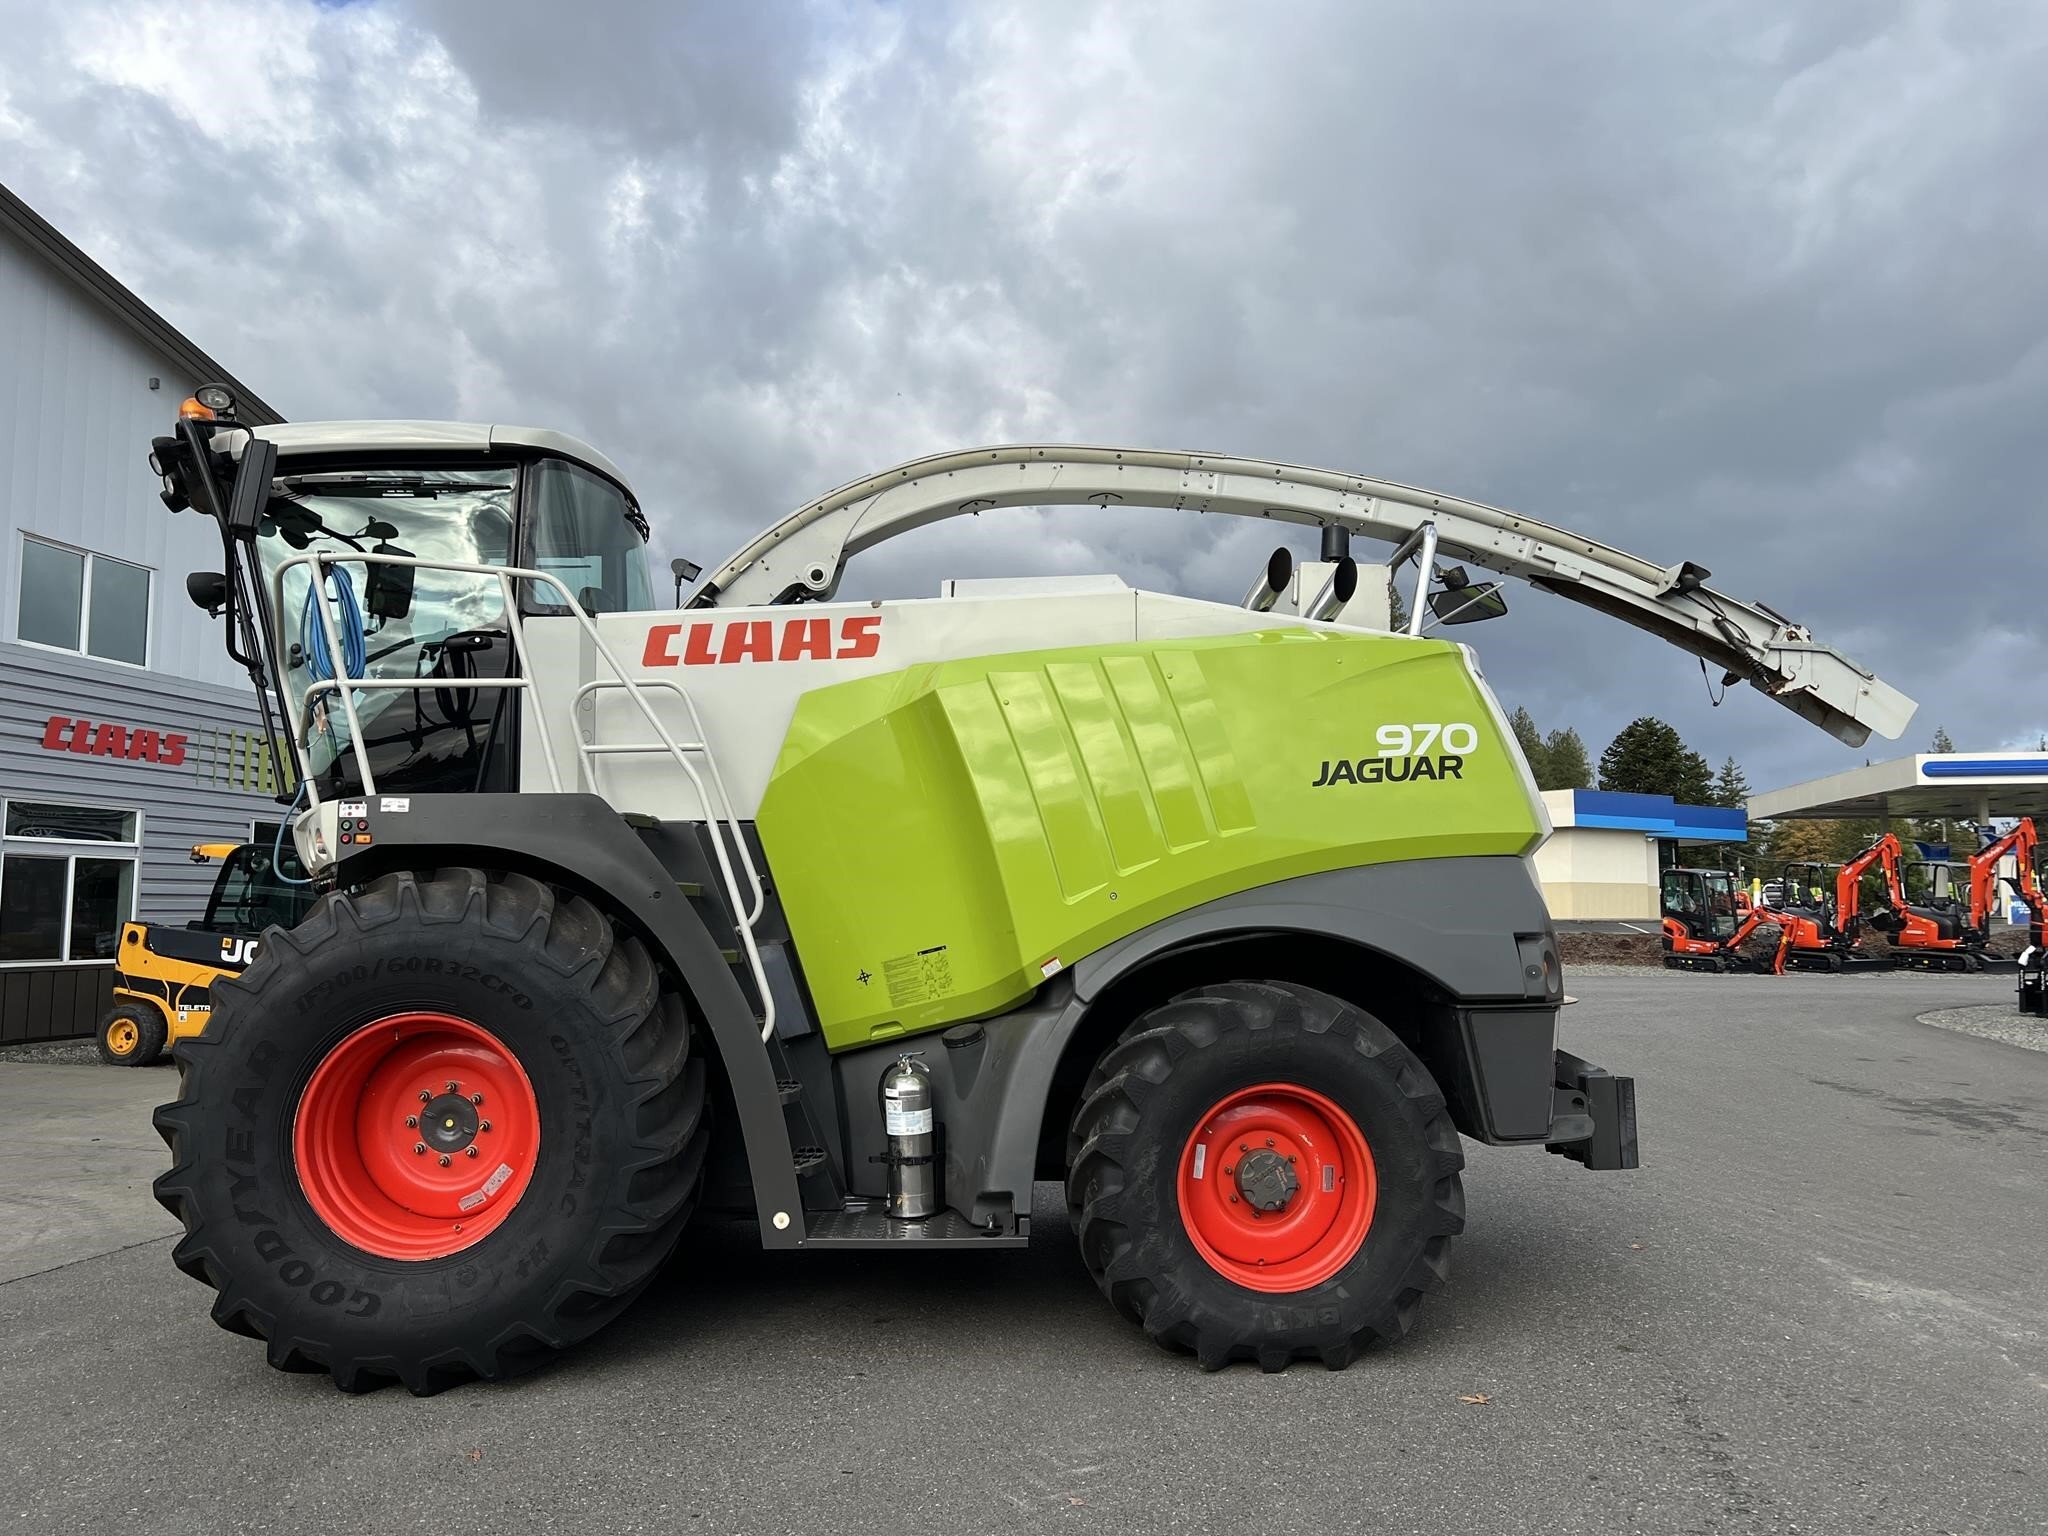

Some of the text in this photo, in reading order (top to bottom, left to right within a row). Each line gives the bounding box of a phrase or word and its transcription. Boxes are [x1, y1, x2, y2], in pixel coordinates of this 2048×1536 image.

[642, 616, 882, 667] CLAAS
[42, 716, 188, 765] CLAAS
[1376, 723, 1478, 757] 970
[1312, 755, 1463, 787] JAGUAR
[224, 1039, 382, 1318] GOODYEAR
